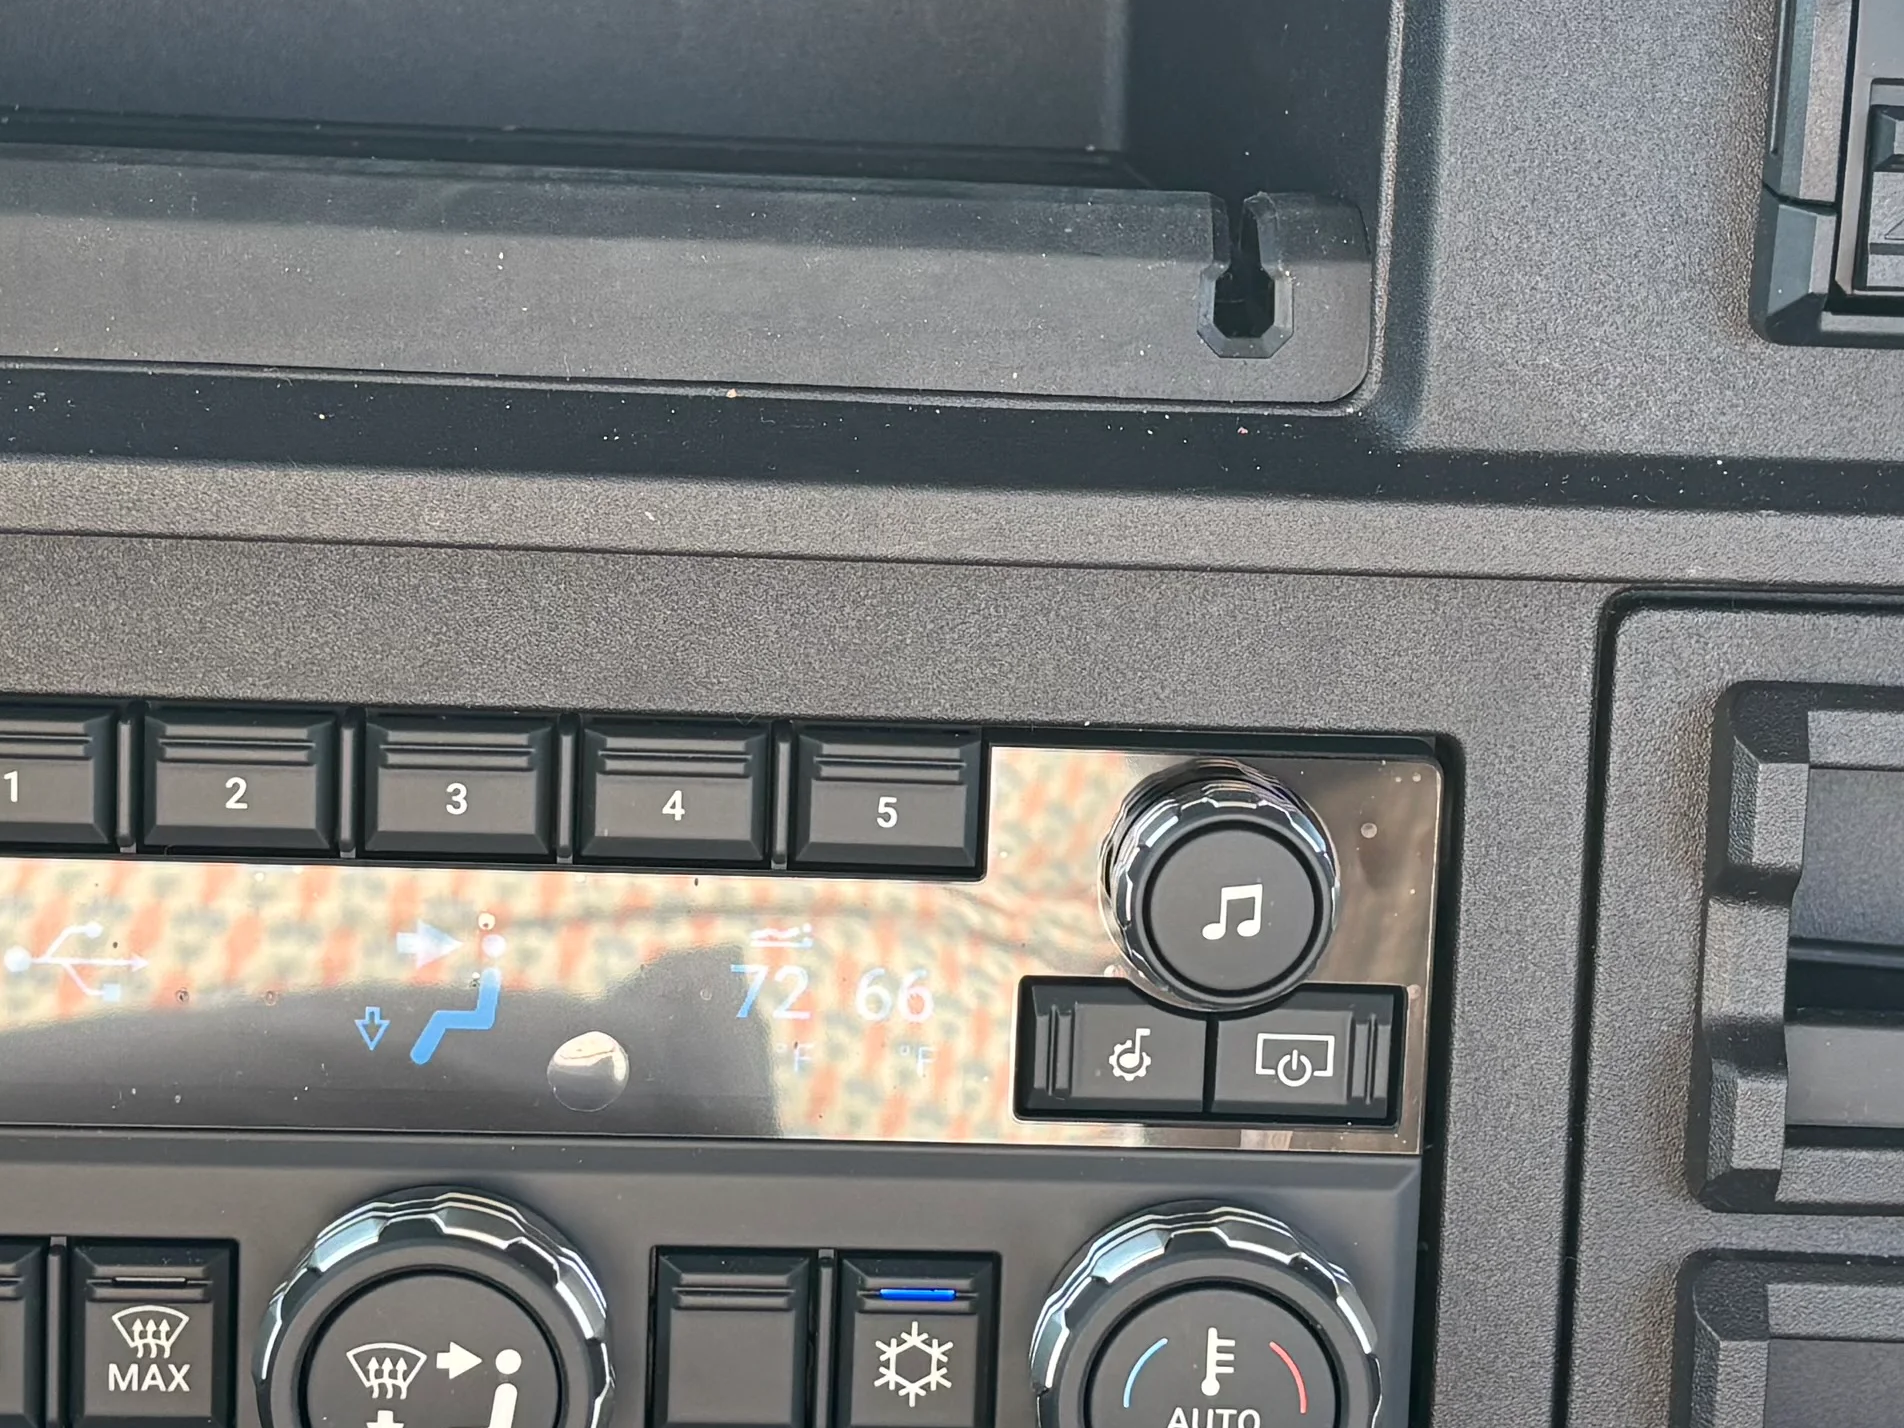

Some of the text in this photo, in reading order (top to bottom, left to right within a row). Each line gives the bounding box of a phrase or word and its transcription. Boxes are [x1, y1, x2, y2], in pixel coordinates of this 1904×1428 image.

[3, 770, 18, 803] 1
[225, 776, 248, 810] 2
[445, 782, 468, 815] 3
[661, 789, 686, 821] 4
[876, 796, 898, 828] 5
[730, 964, 812, 1020] 72
[855, 967, 933, 1022] 66
[108, 1361, 191, 1393] MAX
